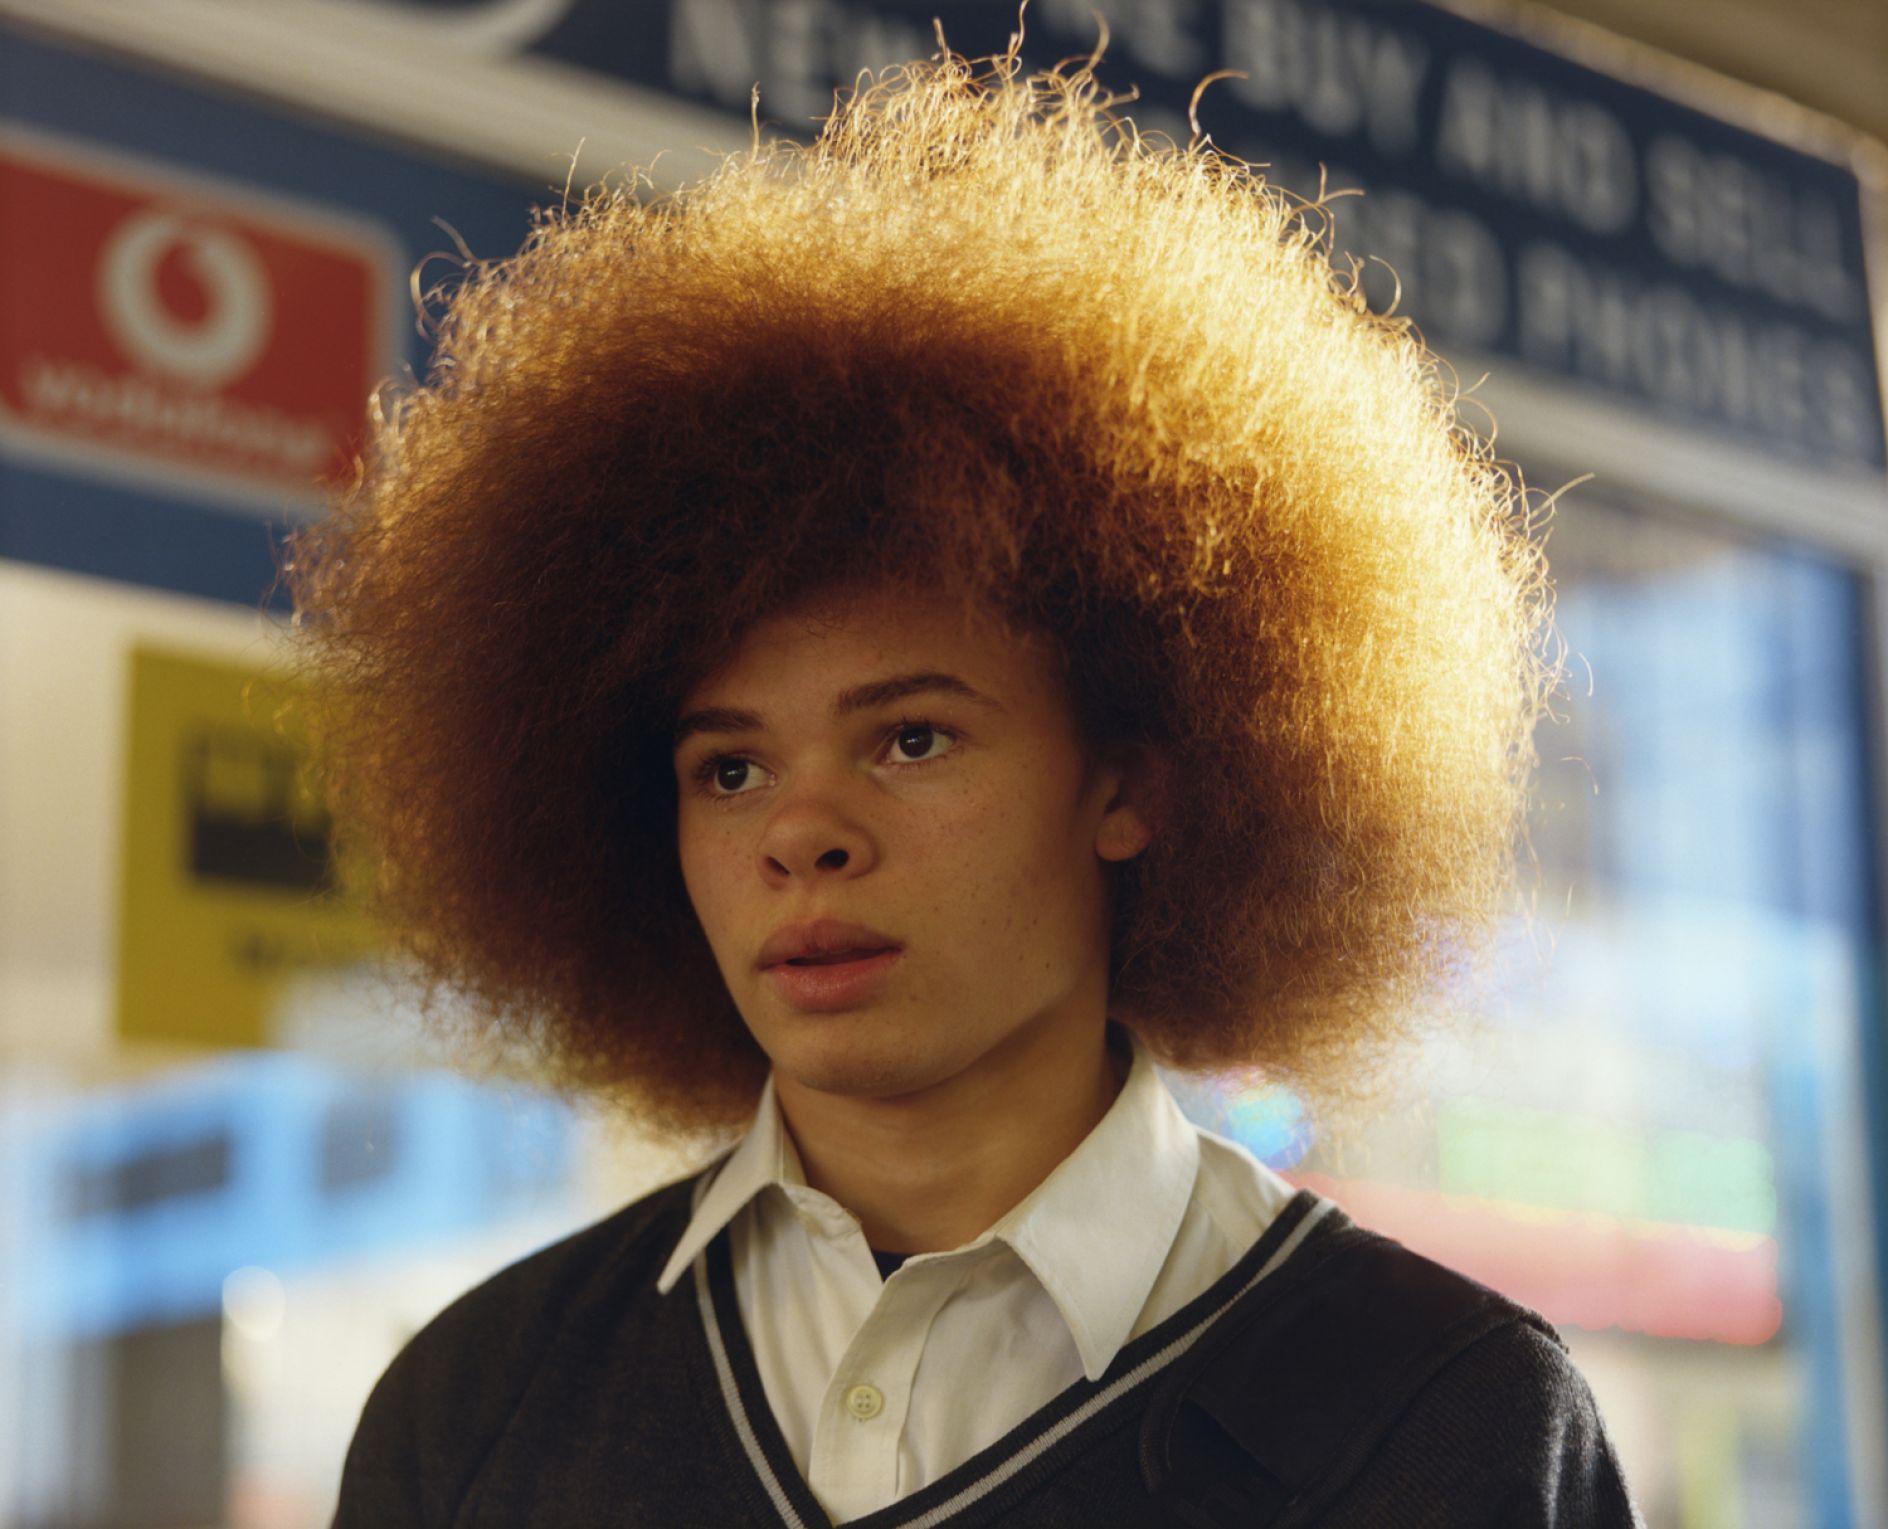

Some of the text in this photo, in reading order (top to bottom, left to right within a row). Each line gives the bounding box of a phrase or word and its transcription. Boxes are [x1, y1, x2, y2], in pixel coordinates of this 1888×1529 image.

[1222, 0, 1427, 156] BUY
[1436, 56, 1640, 236] AND
[1648, 133, 1858, 323] SELL
[1518, 240, 1880, 462] PHONES
